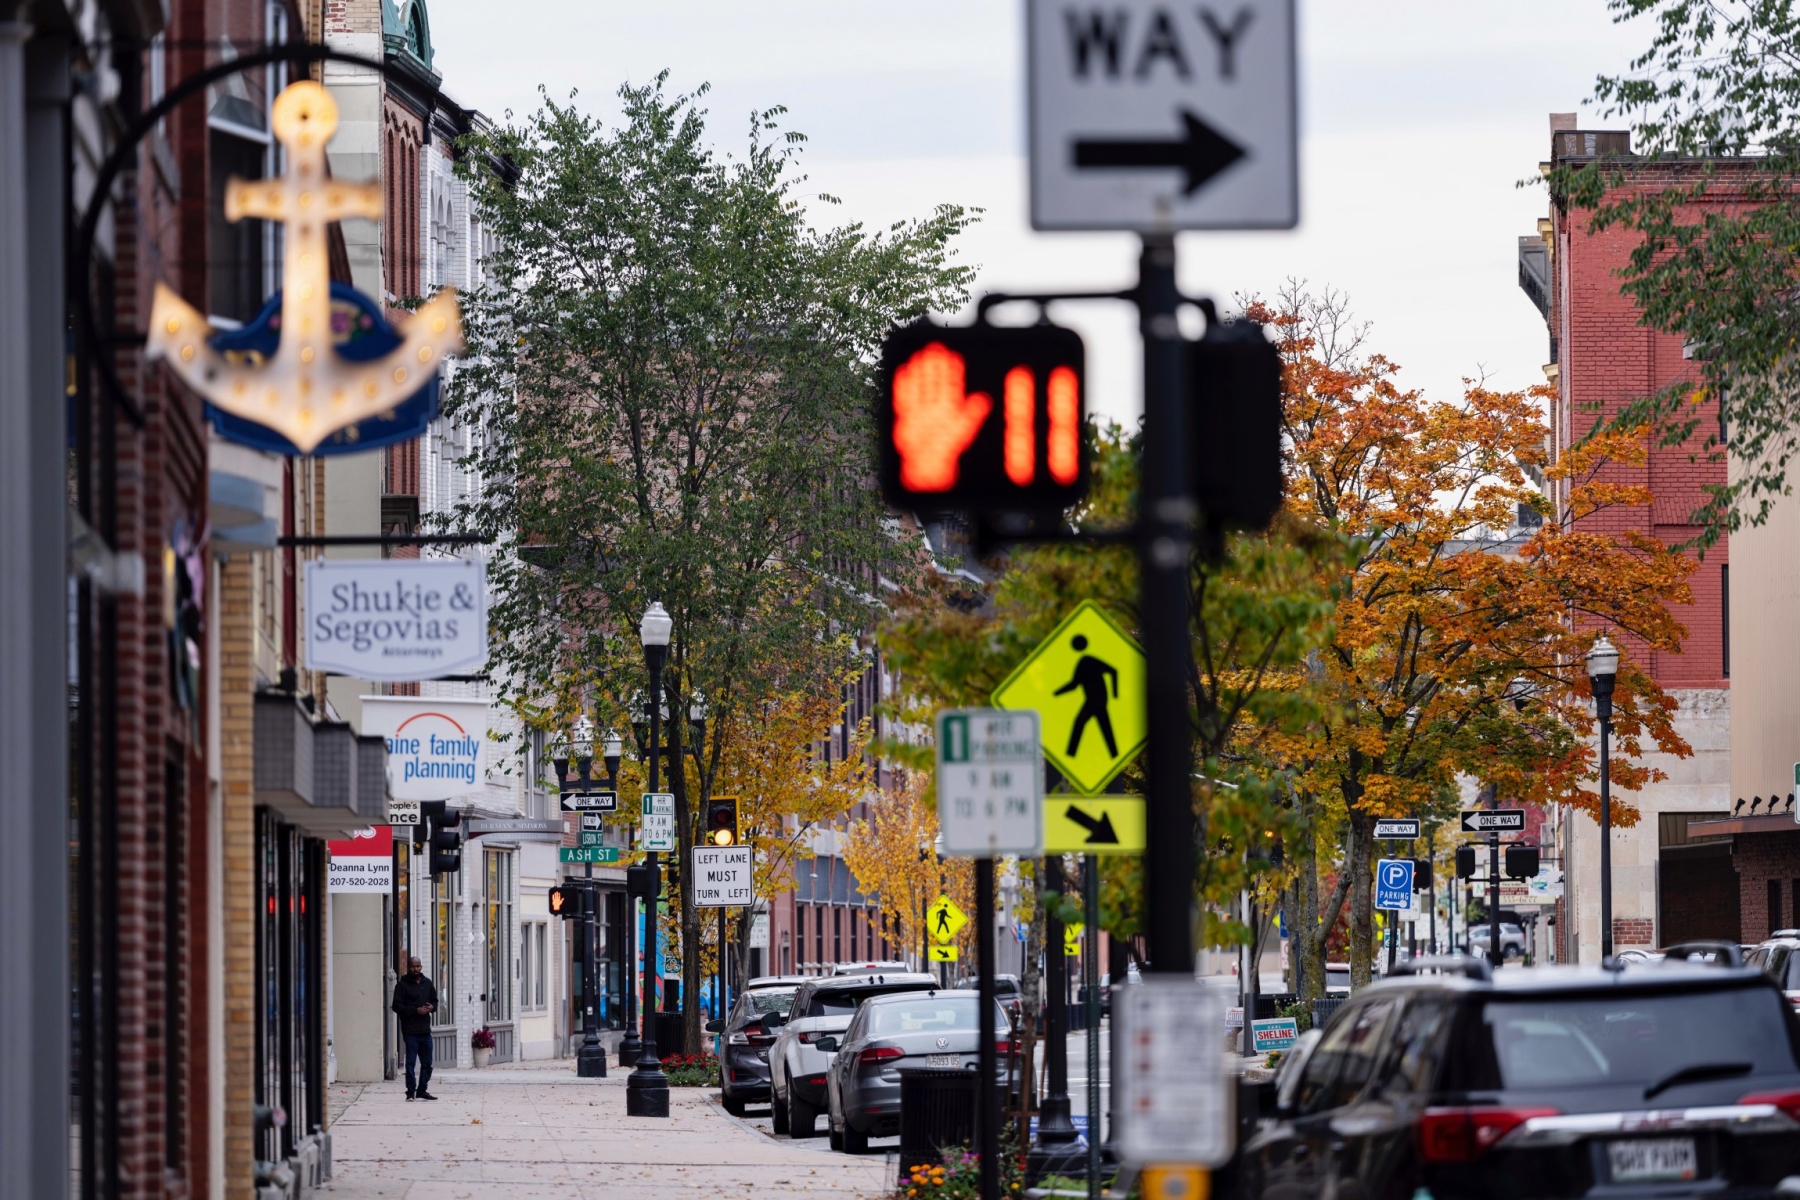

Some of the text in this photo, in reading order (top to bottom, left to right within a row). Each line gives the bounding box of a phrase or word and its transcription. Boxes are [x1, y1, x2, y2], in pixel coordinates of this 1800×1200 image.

[1063, 6, 1256, 81] WAY
[1003, 363, 1080, 487] 11
[331, 580, 475, 618] Shukie &
[315, 613, 459, 652] Segovias
[382, 646, 444, 659] Attorneys
[949, 720, 963, 760] 1
[387, 733, 480, 761] aine family
[404, 756, 476, 784] planning
[389, 801, 418, 811] eople's
[576, 797, 611, 806] ONE WAY
[645, 797, 650, 814] 1
[652, 805, 672, 813] PARKING
[390, 813, 418, 823] nce
[649, 816, 667, 827] 9 AM
[1480, 816, 1518, 825] ONE WAY
[644, 828, 672, 839] TO 6 PM
[1379, 825, 1395, 833] ONE
[582, 833, 603, 845] LISBON ST
[567, 849, 611, 861] ASH ST
[698, 853, 748, 864] LEFT LANE
[330, 863, 390, 873] Deanna Lynn
[330, 877, 390, 886] 207-520-2028
[707, 870, 737, 882] MUST
[1389, 867, 1404, 885] P
[696, 888, 749, 899] TURN LEFT
[1380, 890, 1409, 901] PARKING
[1257, 1029, 1294, 1040] SHELINE
